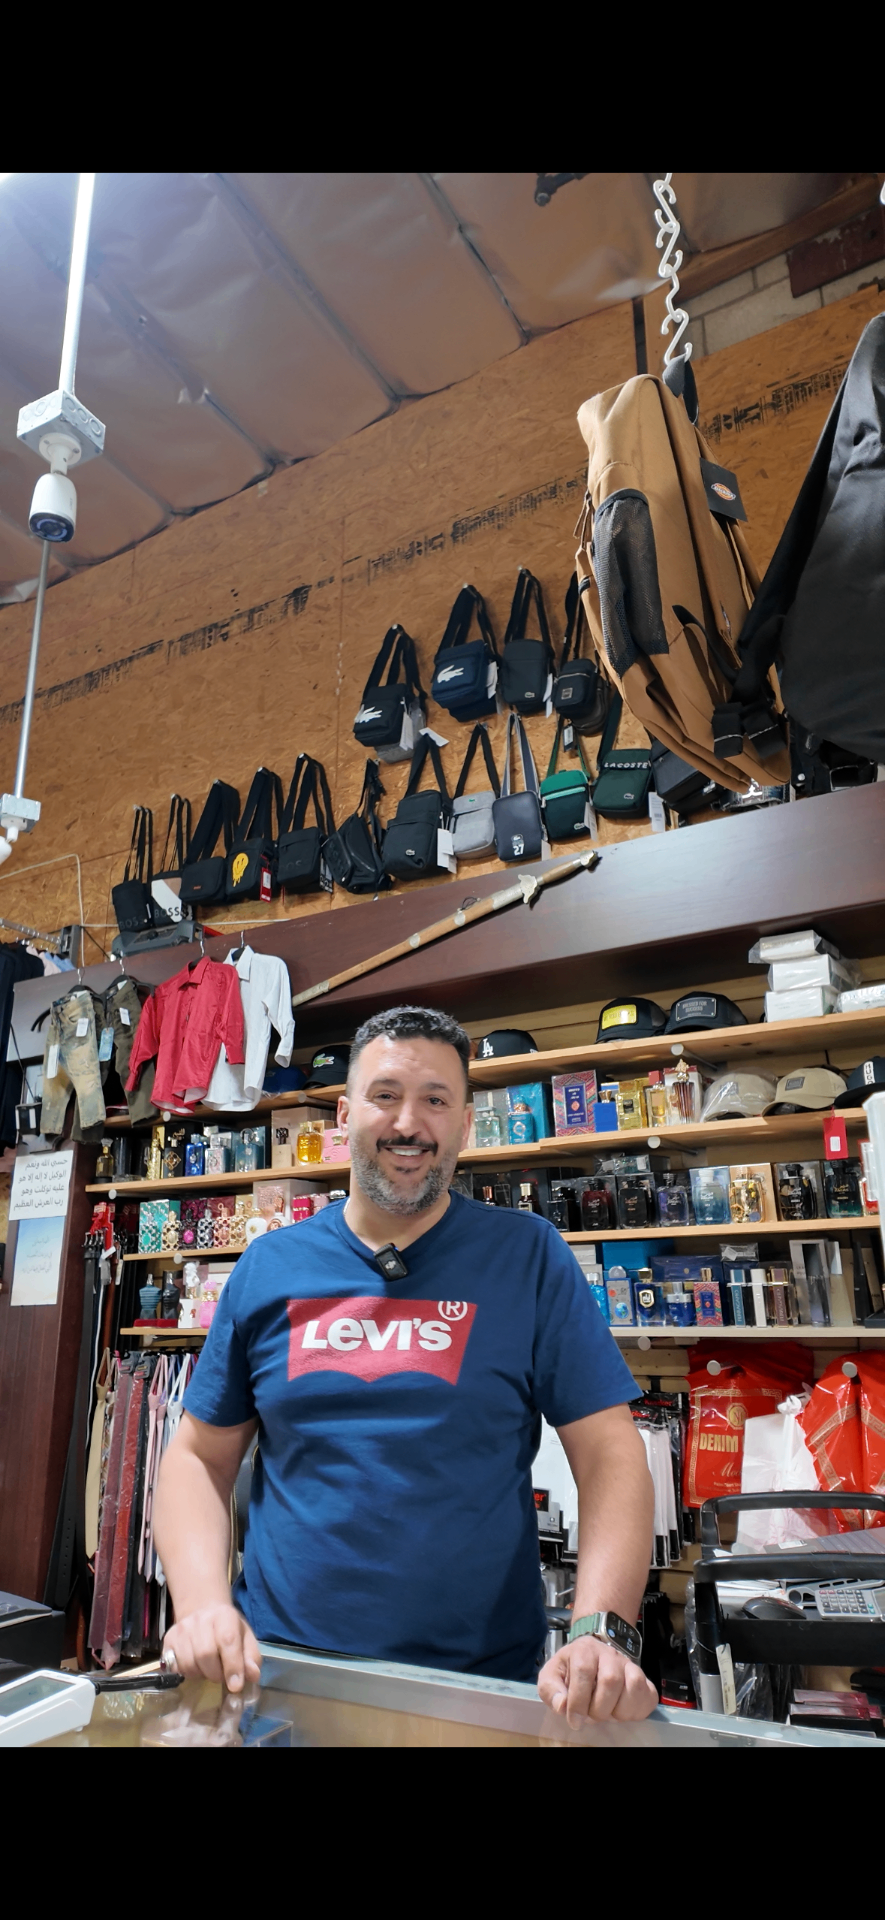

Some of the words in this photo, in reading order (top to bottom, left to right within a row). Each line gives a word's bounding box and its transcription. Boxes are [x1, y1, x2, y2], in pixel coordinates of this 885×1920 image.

[512, 843, 525, 856] 27
[154, 906, 180, 919] BOSS
[482, 1038, 494, 1057] LA
[41, 1159, 50, 1167] الله
[18, 1176, 26, 1184] هو
[49, 1170, 67, 1181] الوكيل
[21, 1188, 33, 1196] وهو
[52, 1183, 65, 1193] عليه
[14, 1199, 34, 1211] العظيم
[699, 1433, 739, 1453] DENIM
